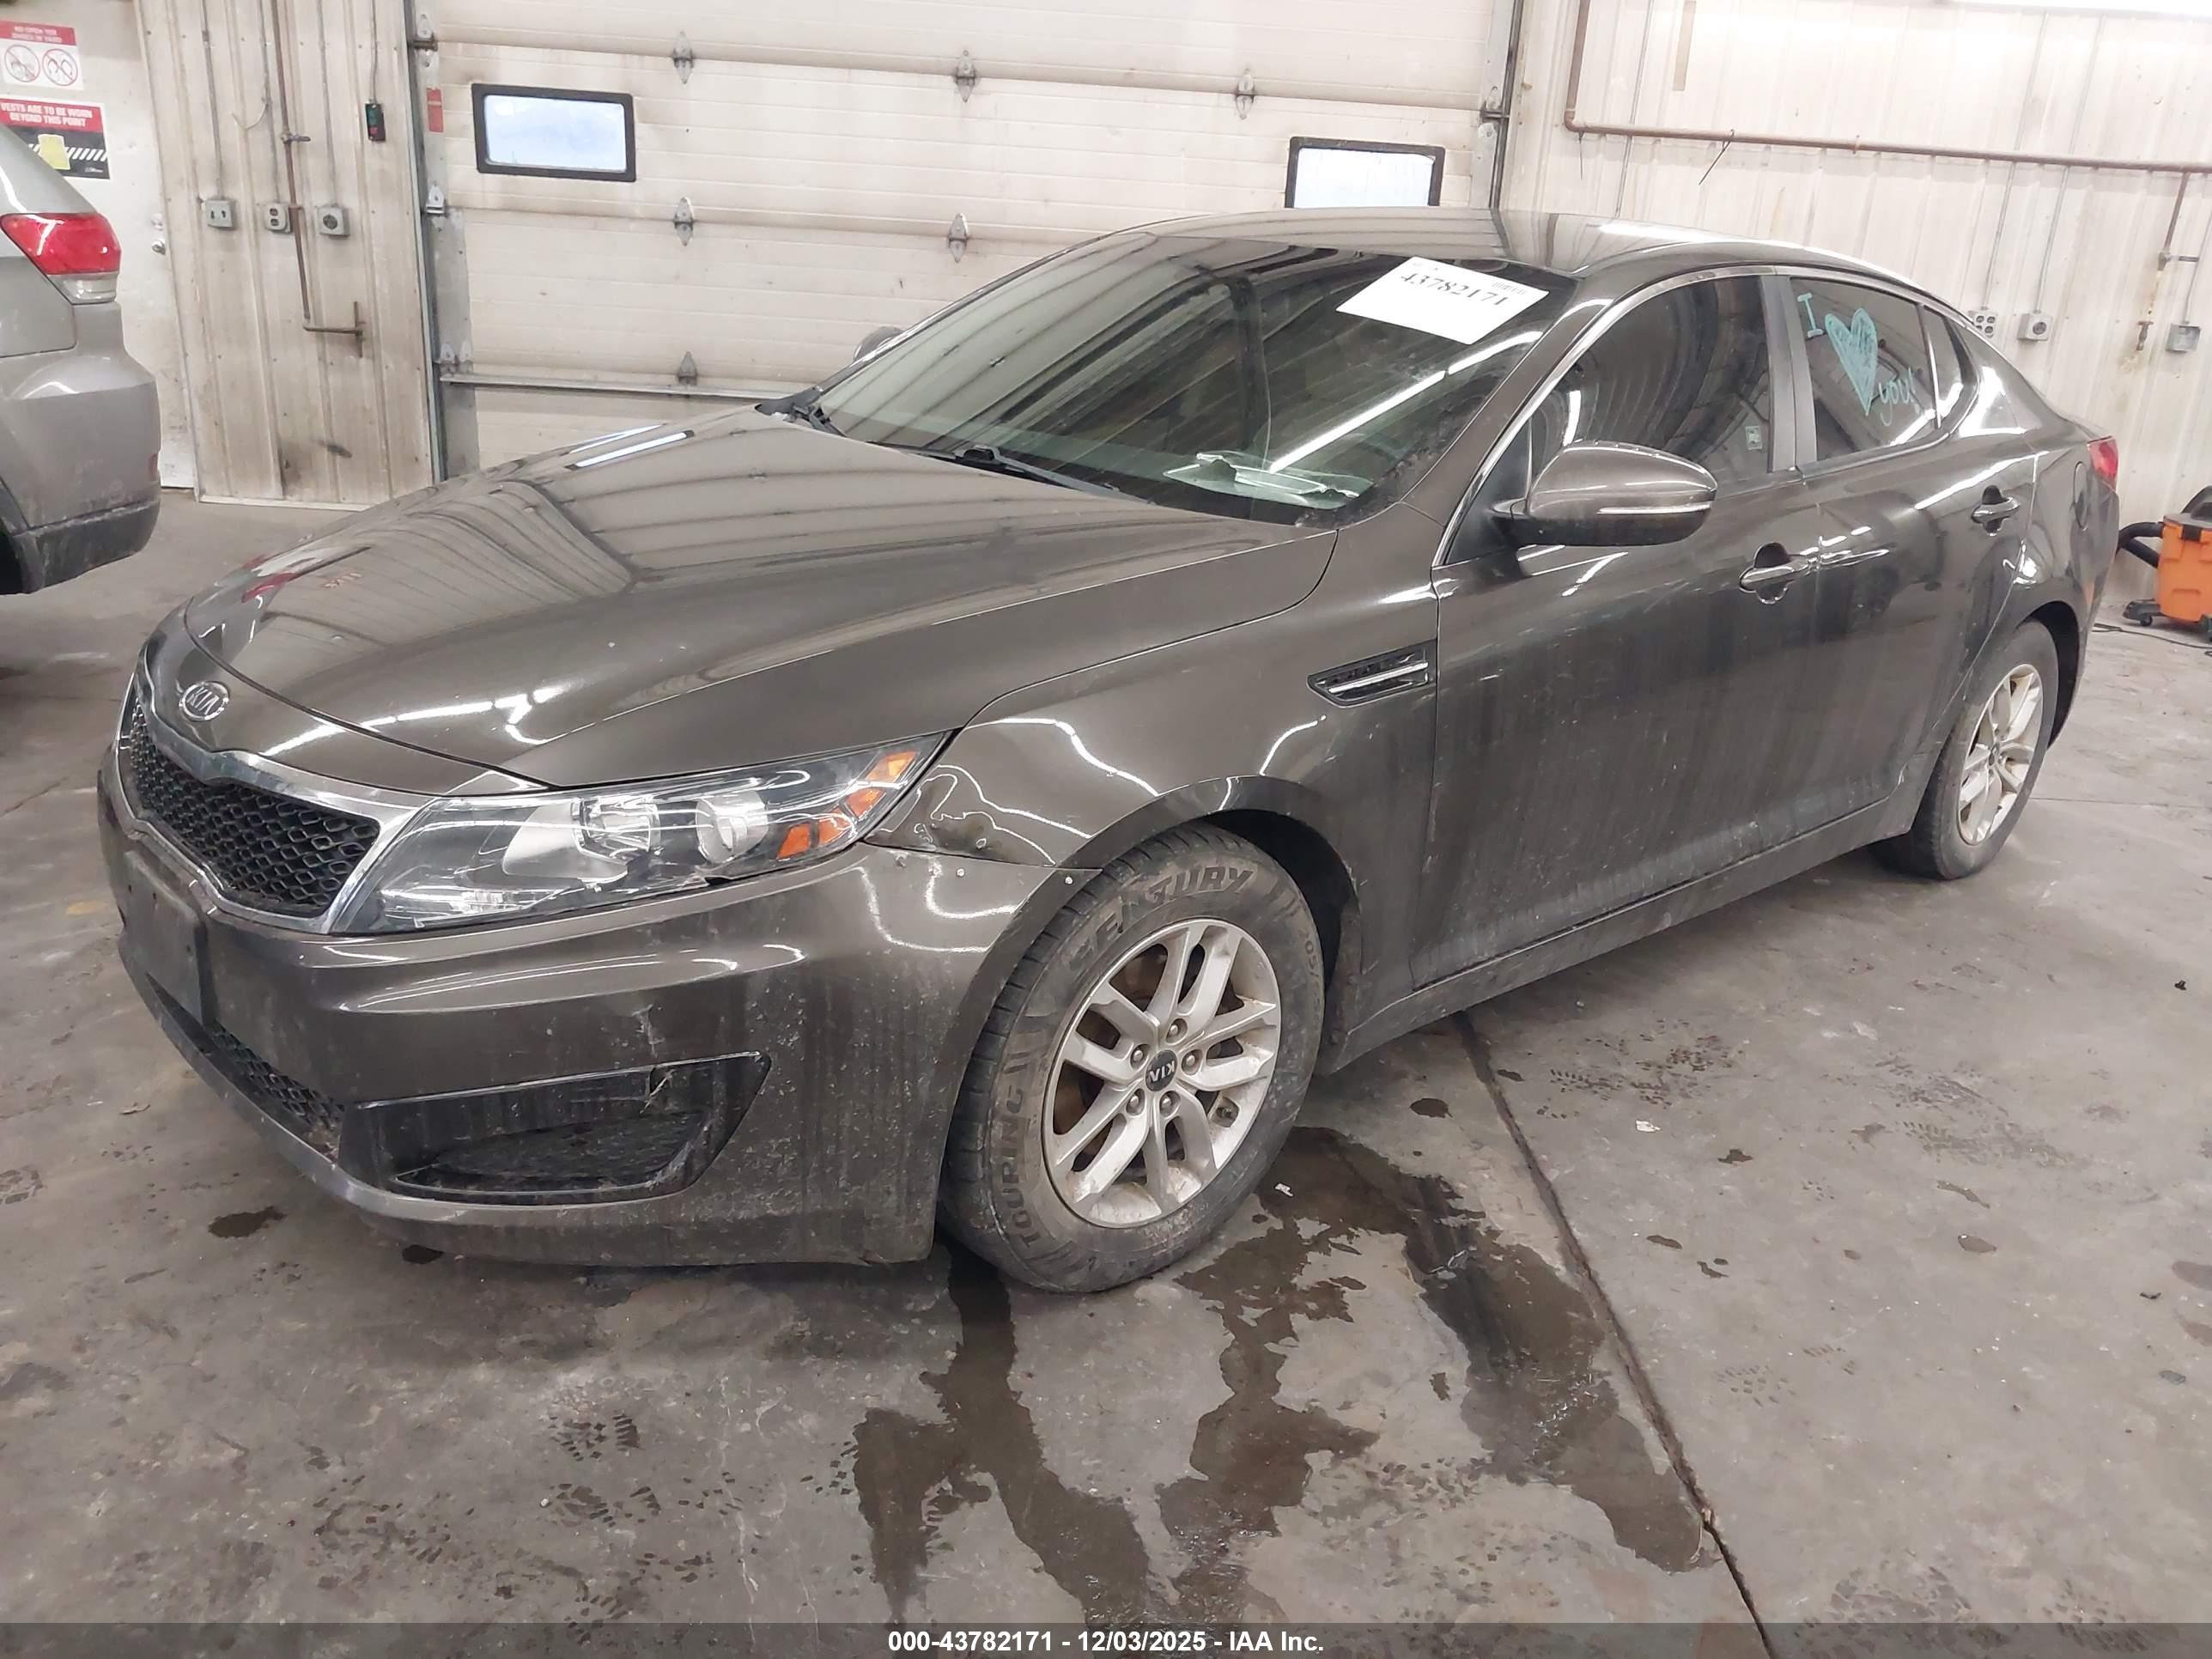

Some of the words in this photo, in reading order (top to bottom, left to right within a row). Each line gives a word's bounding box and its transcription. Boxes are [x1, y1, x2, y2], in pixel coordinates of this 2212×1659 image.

[27, 104, 42, 113] ARE
[44, 106, 55, 115] TO
[56, 107, 67, 117] BE
[9, 112, 42, 124] BEYOND
[43, 115, 62, 125] THIS
[63, 118, 86, 127] POINT
[1401, 273, 1509, 306] 43782171
